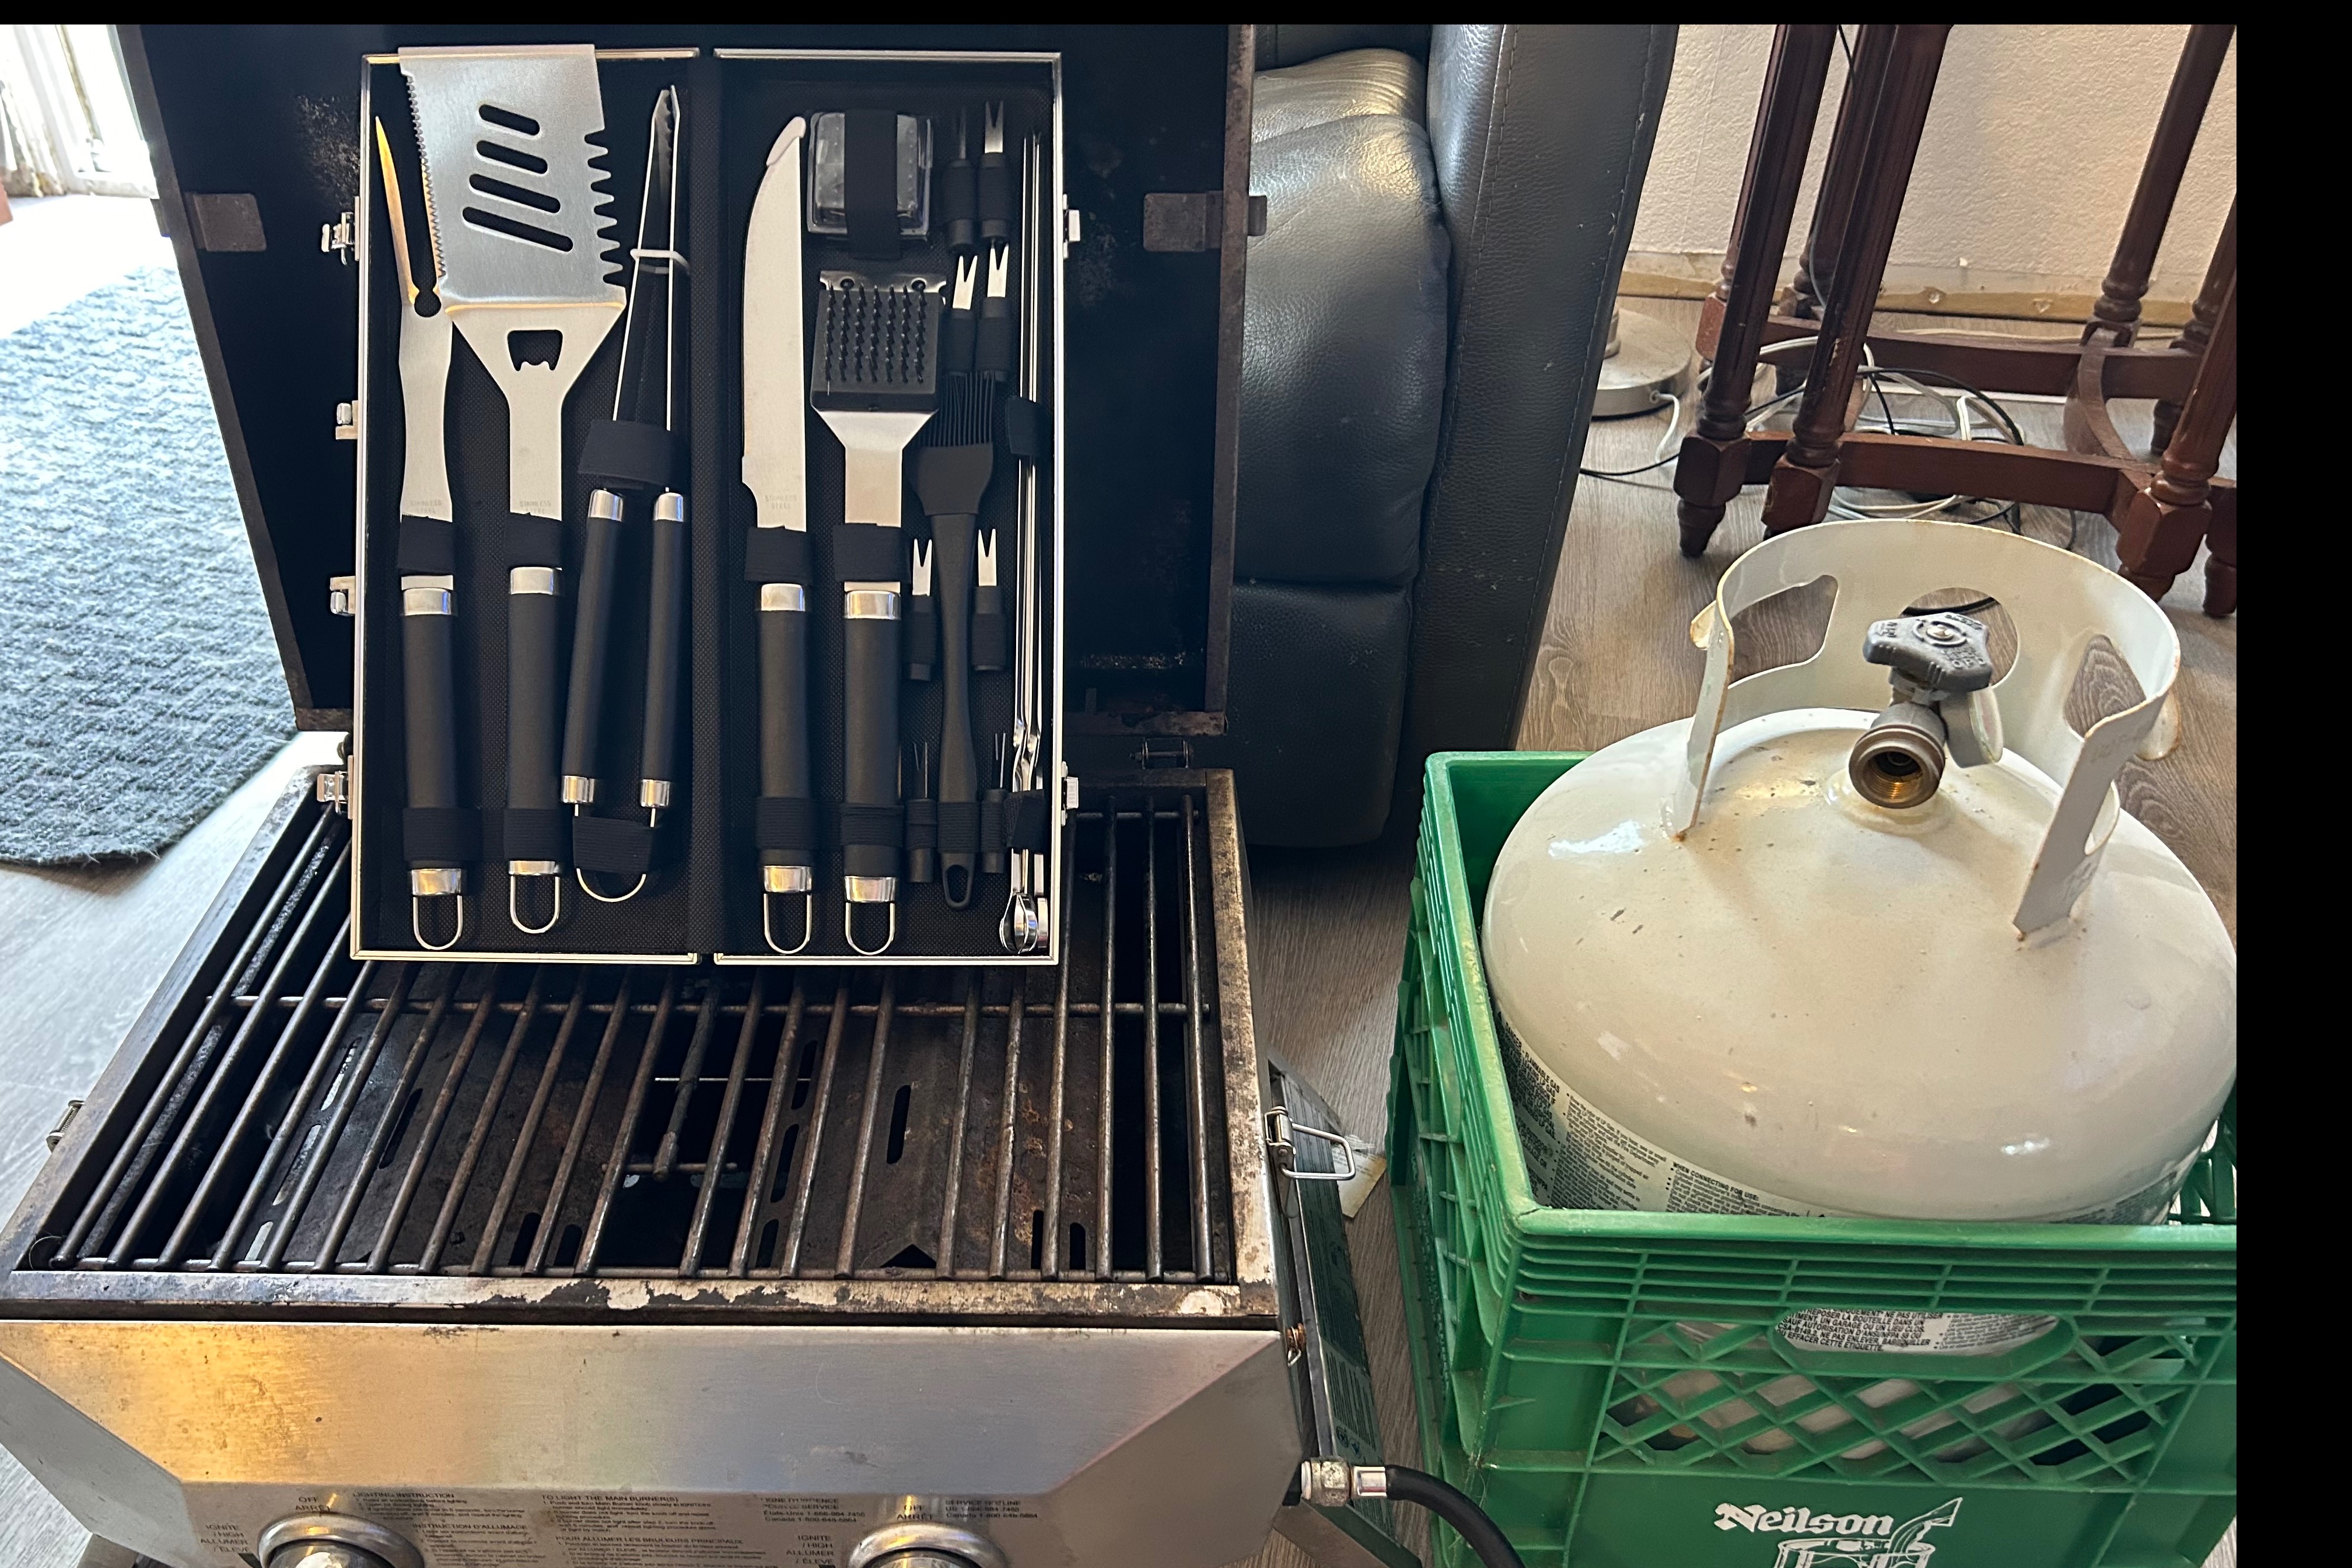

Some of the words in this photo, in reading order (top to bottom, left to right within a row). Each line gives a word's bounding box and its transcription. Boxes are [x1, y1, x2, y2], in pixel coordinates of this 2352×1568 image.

[1550, 1079, 1560, 1093] GAS
[1690, 1170, 1729, 1191] CONNECTING
[1803, 1321, 1855, 1335] AUTORISATION
[1833, 1318, 1861, 1329] GARAGE
[1787, 1331, 1819, 1344] EFFACER
[1820, 1338, 1843, 1348] CETTE
[1714, 1502, 1894, 1535] Neilson
